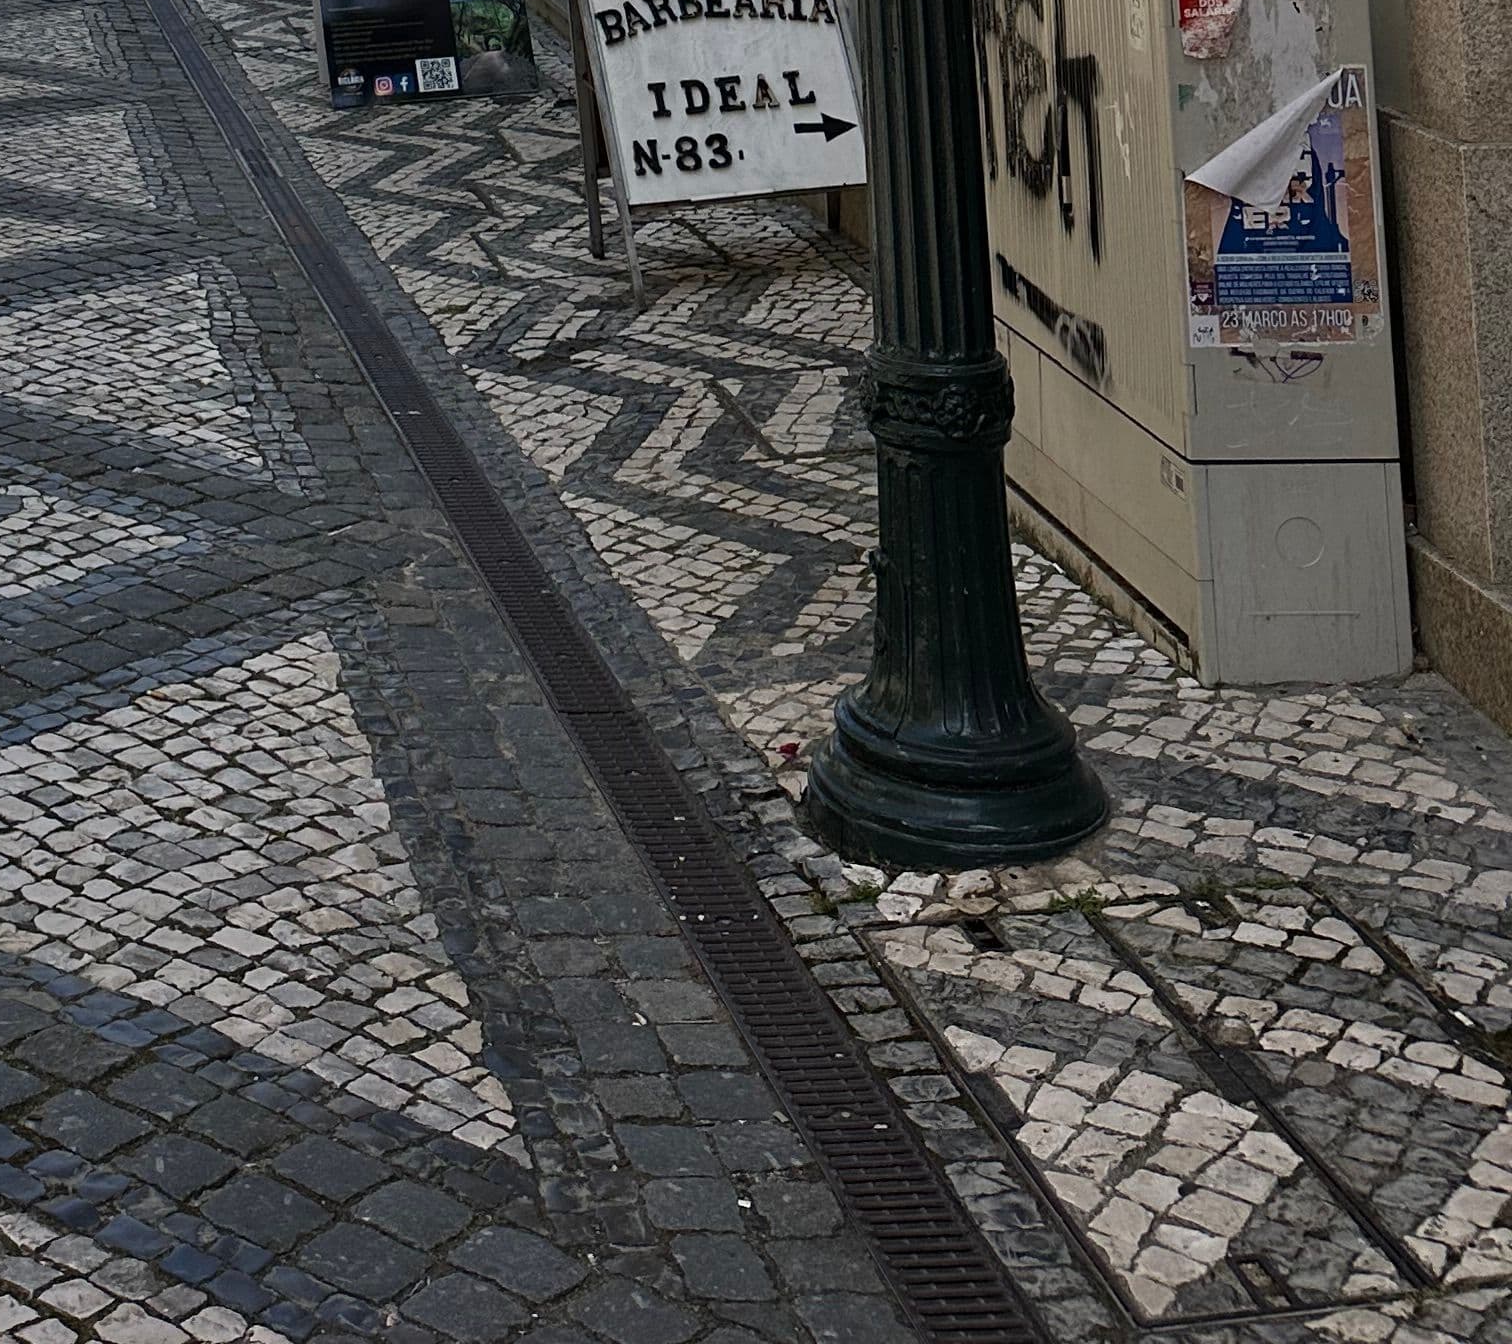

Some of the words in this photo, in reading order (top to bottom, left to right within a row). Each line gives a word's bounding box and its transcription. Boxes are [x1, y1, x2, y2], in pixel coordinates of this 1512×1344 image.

[1198, 0, 1224, 7] DOS
[647, 70, 816, 118] IDEAL
[1222, 311, 1239, 328] 23
[1311, 309, 1353, 327] 17H00
